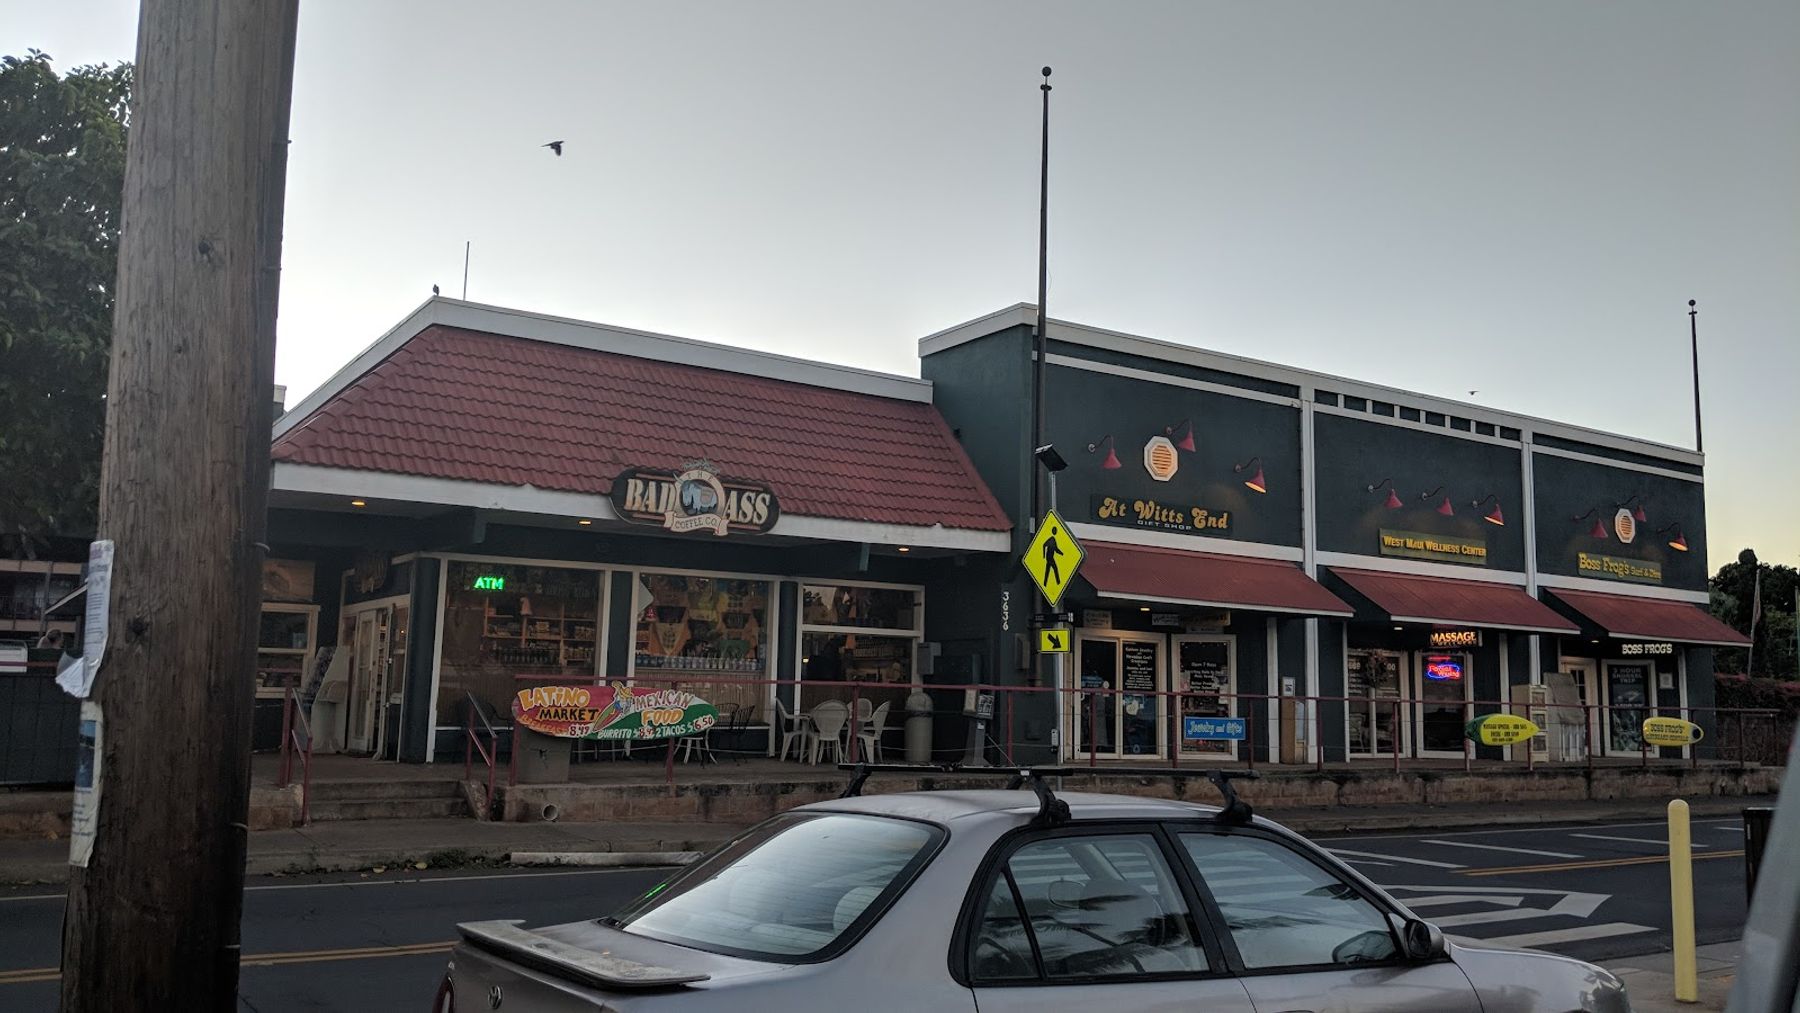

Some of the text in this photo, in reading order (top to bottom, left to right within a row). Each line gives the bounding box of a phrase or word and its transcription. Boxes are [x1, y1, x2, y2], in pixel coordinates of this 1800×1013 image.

[624, 478, 771, 526] BAD ASS
[1098, 497, 1229, 530] At Witts End
[675, 517, 705, 530] COFFEE
[1137, 520, 1192, 531] GIFT SHOP
[1461, 545, 1487, 557] CENTER
[1578, 552, 1601, 571] Boss
[473, 576, 505, 590] ATM
[1002, 591, 1010, 631] 3636
[1430, 631, 1477, 643] MASSAGE
[1621, 643, 1643, 655] BOSS
[634, 691, 694, 713] MEXICAN
[539, 708, 599, 722] MARKET
[641, 709, 686, 726] FOOD
[598, 729, 631, 739] BURRITO
[656, 728, 662, 738] 2
[663, 724, 686, 737] TACOS
